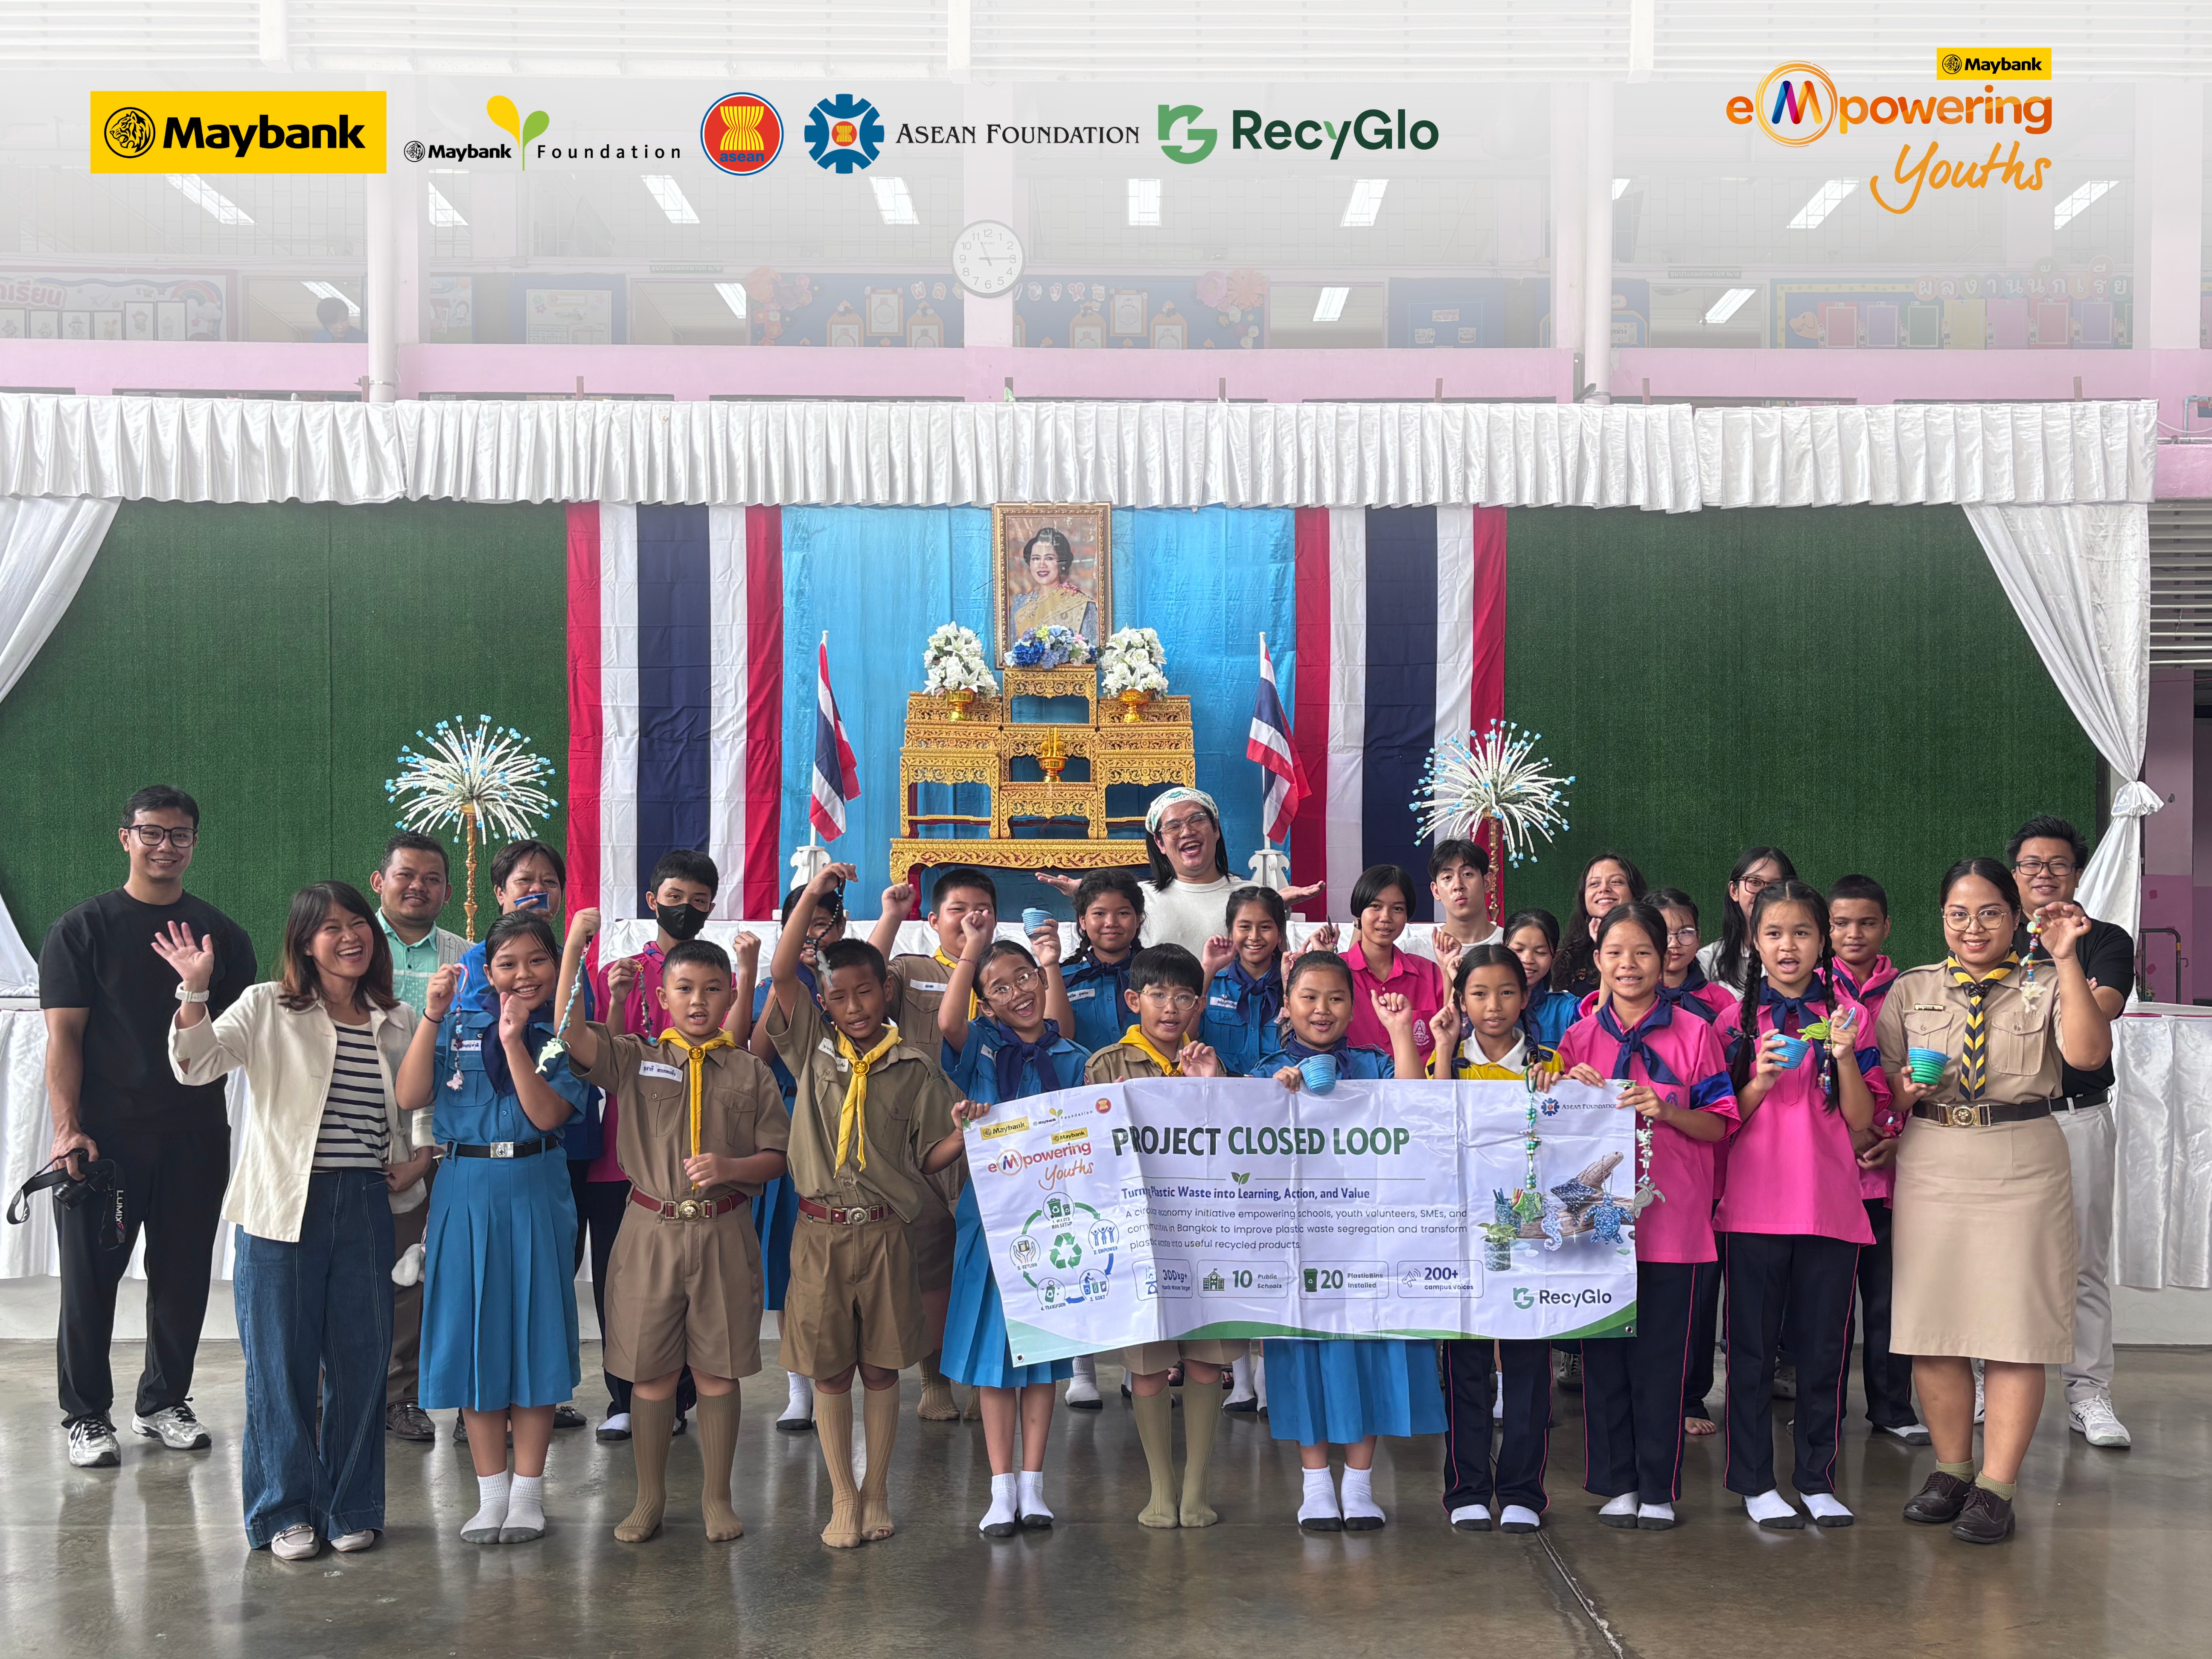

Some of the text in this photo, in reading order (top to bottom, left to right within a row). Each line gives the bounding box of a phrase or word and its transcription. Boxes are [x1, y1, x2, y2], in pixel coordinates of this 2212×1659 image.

[972, 233, 980, 241] 11
[983, 229, 993, 238] 12
[998, 233, 1002, 241] 1
[962, 242, 972, 250] 10
[1007, 241, 1013, 250] 2
[959, 254, 966, 263] 9
[1010, 254, 1016, 263] 3
[962, 268, 969, 276] 8
[1006, 267, 1013, 276] 4
[973, 276, 979, 285] 7
[997, 276, 1004, 285] 5
[1918, 263, 2129, 295] ผลงานนักเรีย
[984, 280, 991, 289] 6
[992, 1122, 1025, 1134] Maybank
[1060, 1131, 1085, 1140] Maybank
[1111, 1126, 1410, 1156] PROJECT CLOSED LOOP
[1038, 1158, 1094, 1190] Youths
[1178, 1186, 1211, 1198] Waste
[1214, 1188, 1235, 1198] into
[1238, 1188, 1281, 1201] Learning,
[1284, 1188, 1318, 1199] Action,
[1320, 1188, 1338, 1198] and
[1341, 1187, 1370, 1198] Value
[115, 1190, 124, 1223] LUMIX
[1195, 1208, 1235, 1218] initiative
[1238, 1211, 1295, 1220] empowering
[1298, 1209, 1333, 1218] schools,
[1336, 1209, 1362, 1220] youth
[1365, 1209, 1417, 1218] volunteers,
[1420, 1210, 1446, 1218] SMEs,
[1449, 1209, 1467, 1217] and
[1169, 1224, 1174, 1232] in
[1177, 1224, 1217, 1234] Bangkok
[1234, 1225, 1272, 1235] improve
[1276, 1225, 1304, 1235] plastic
[1338, 1224, 1394, 1235] segregation
[1398, 1225, 1417, 1233] and
[1421, 1225, 1467, 1233] transform
[1185, 1240, 1212, 1248] useful
[1215, 1240, 1256, 1250] recycled
[1163, 1269, 1187, 1283] 300kg+
[1424, 1267, 1458, 1280] 200+
[1232, 1270, 1253, 1288] 10
[1321, 1269, 1344, 1289] 20
[1540, 1289, 1612, 1308] RecyGlo
